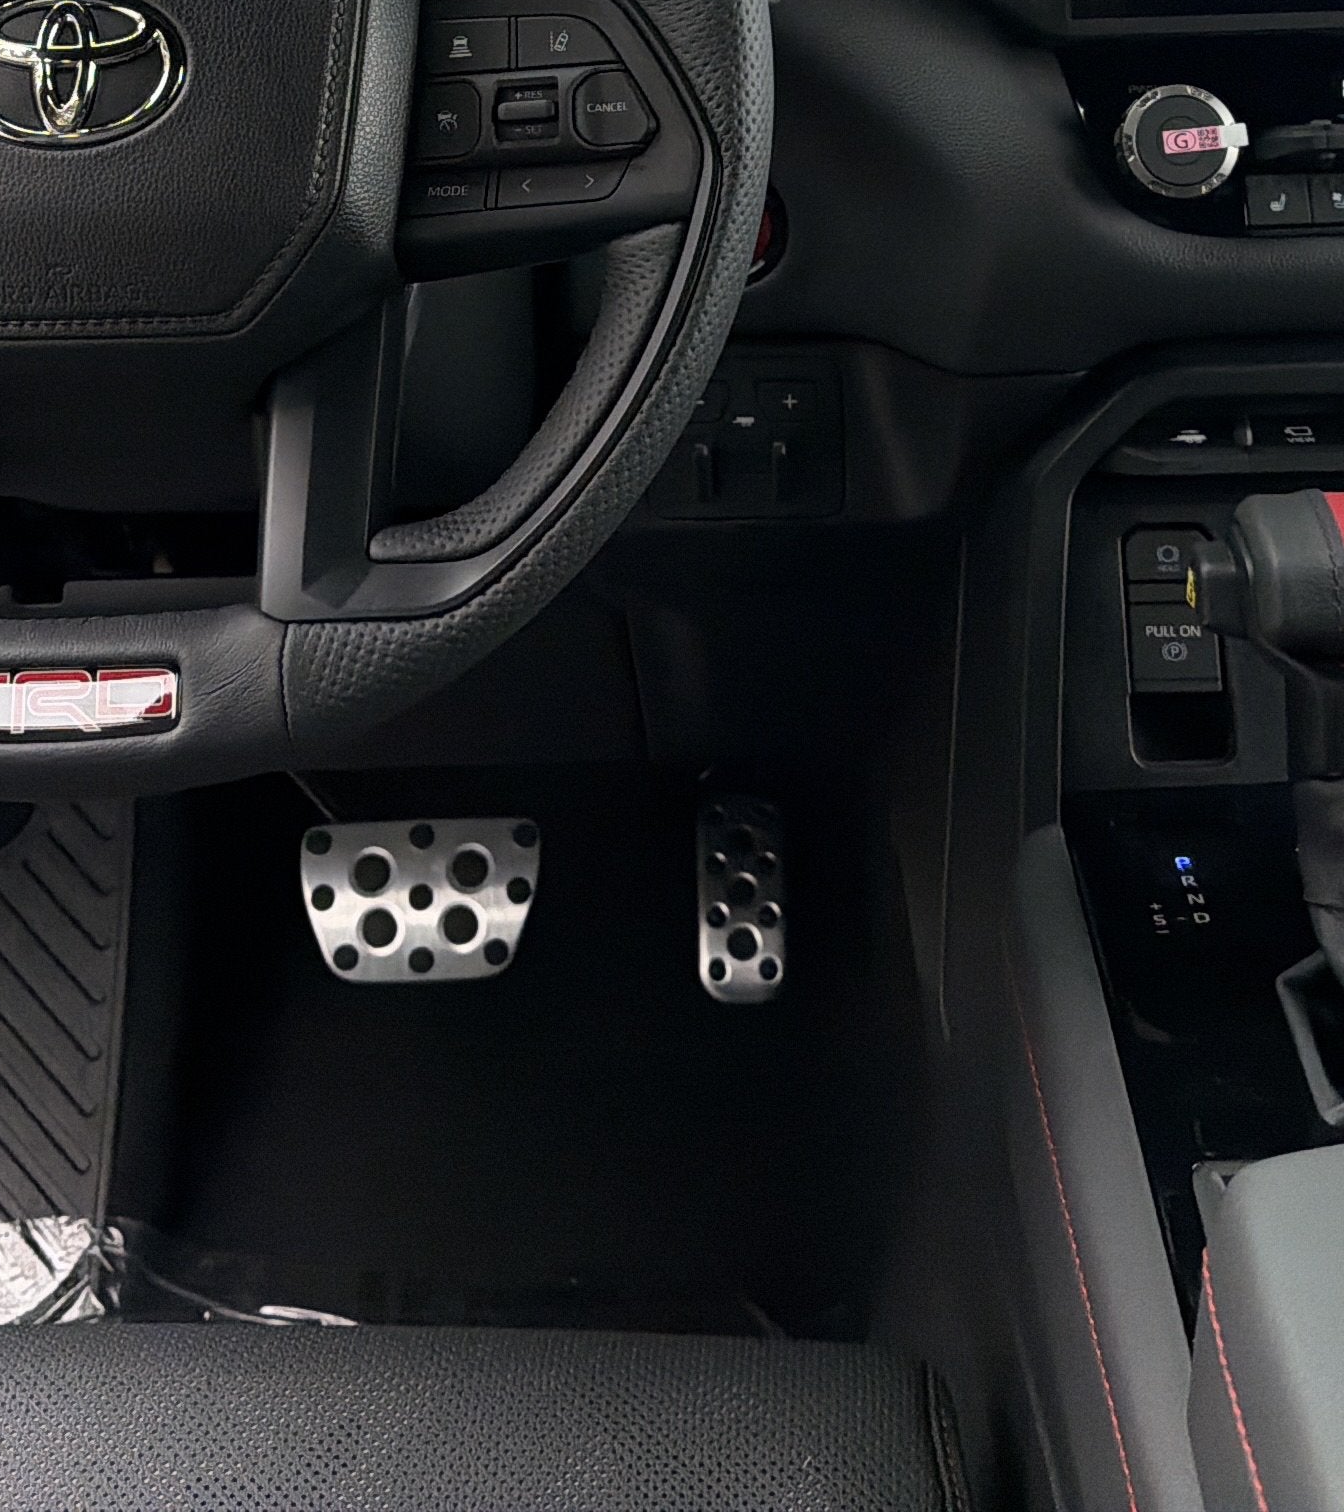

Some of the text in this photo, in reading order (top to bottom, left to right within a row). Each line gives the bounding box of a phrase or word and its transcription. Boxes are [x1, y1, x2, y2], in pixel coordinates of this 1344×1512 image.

[586, 101, 628, 113] CANCEL
[1174, 132, 1189, 149] G
[427, 184, 469, 198] MODE
[1145, 624, 1202, 638] PULL ON
[1174, 856, 1192, 872] P
[1180, 875, 1199, 887] R
[1186, 893, 1205, 905] N
[1152, 914, 1167, 926] S
[1192, 911, 1211, 924] D
